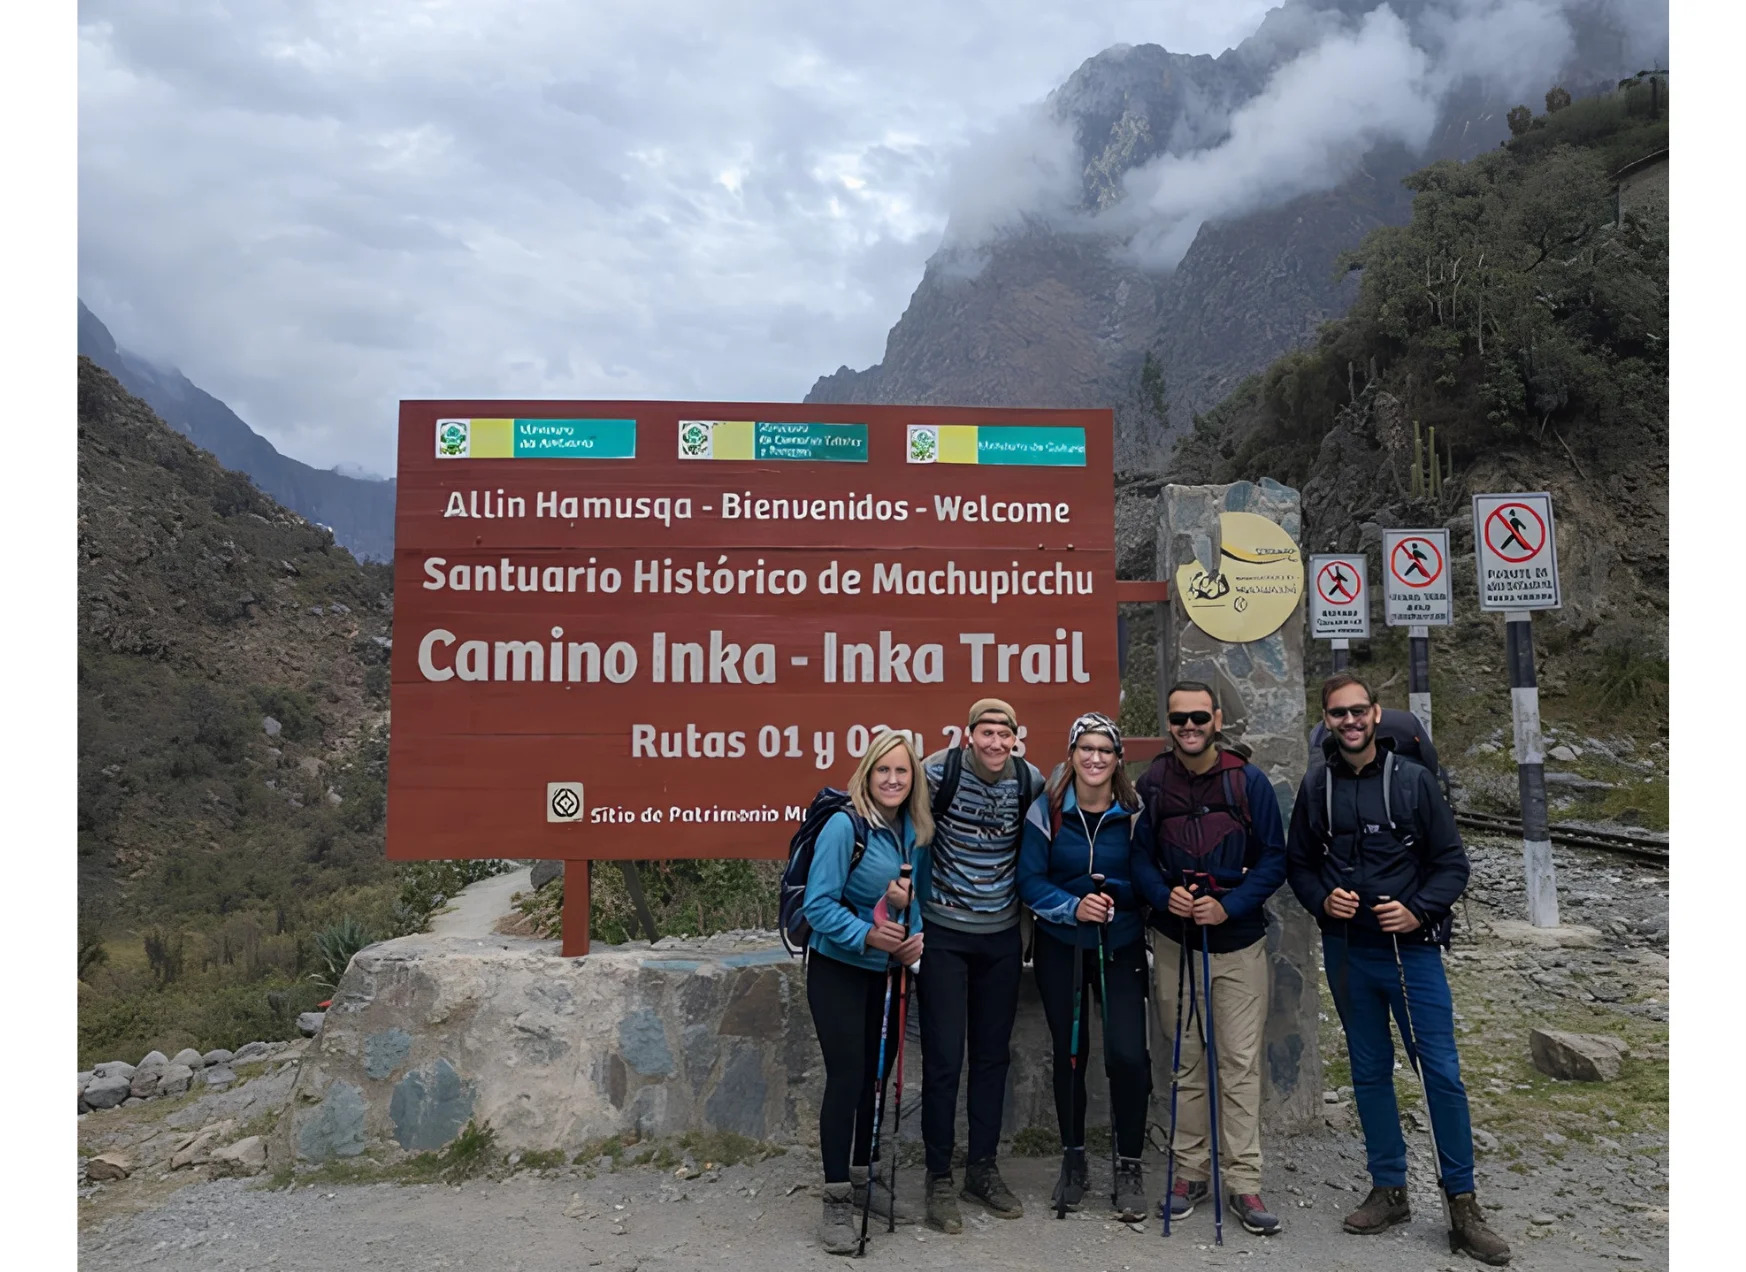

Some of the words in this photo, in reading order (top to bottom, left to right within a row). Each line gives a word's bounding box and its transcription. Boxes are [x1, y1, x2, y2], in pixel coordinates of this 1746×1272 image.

[443, 489, 526, 519] Allin
[536, 491, 693, 528] Hamusqa
[722, 491, 909, 521] Bienvenidos
[934, 495, 1070, 524] Welcome
[422, 557, 622, 593] Santuario
[633, 554, 808, 595] Histórico
[819, 560, 862, 595] de
[872, 561, 1093, 604] Machupicchu
[417, 626, 638, 685] Camino
[652, 630, 776, 685] Inka
[823, 631, 944, 684] Inka
[959, 628, 1090, 684] Trail
[632, 724, 746, 758] Rutas
[758, 725, 803, 758] 01
[813, 732, 835, 770] y
[640, 805, 663, 823] de
[669, 804, 780, 823] Patrimonio
